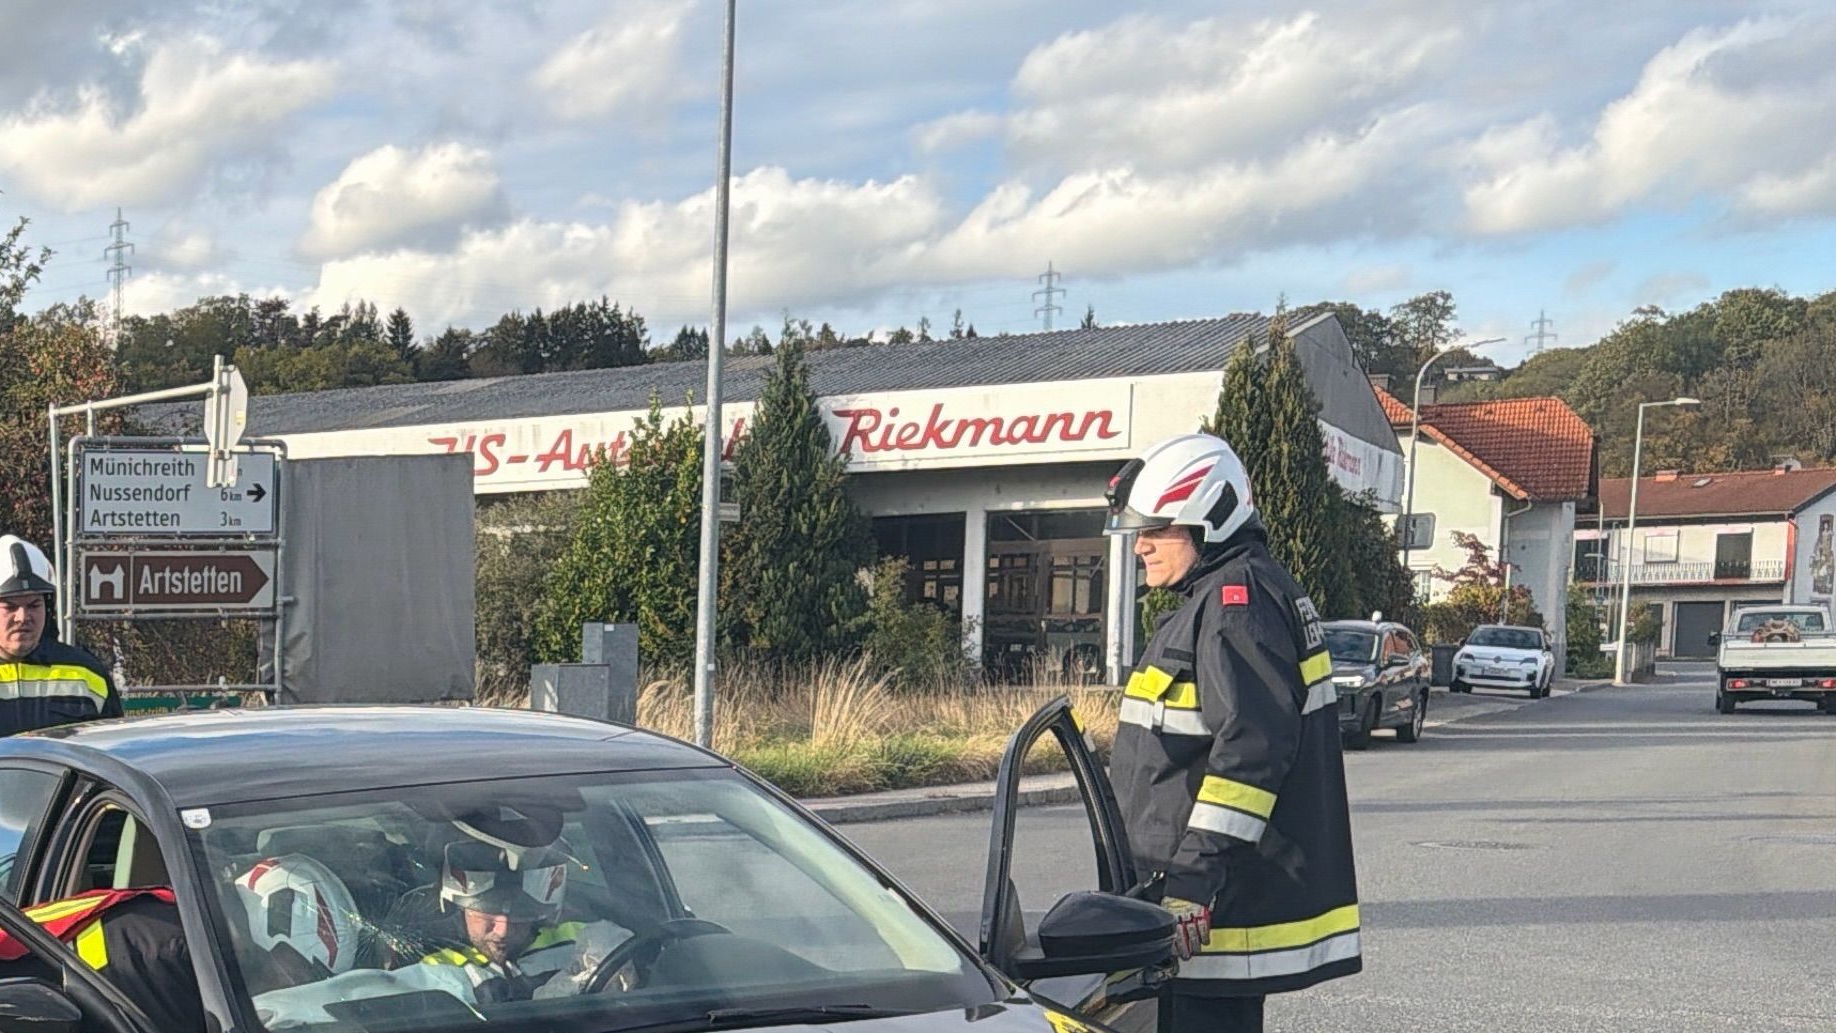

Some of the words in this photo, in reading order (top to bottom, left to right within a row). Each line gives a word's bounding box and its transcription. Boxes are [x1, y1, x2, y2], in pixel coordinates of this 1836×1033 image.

[832, 403, 1122, 454] Riekmann
[90, 457, 195, 476] Münichreith
[90, 484, 191, 501] Nussendorf
[90, 509, 180, 527] Artstetten
[138, 564, 242, 594] Artstetten
